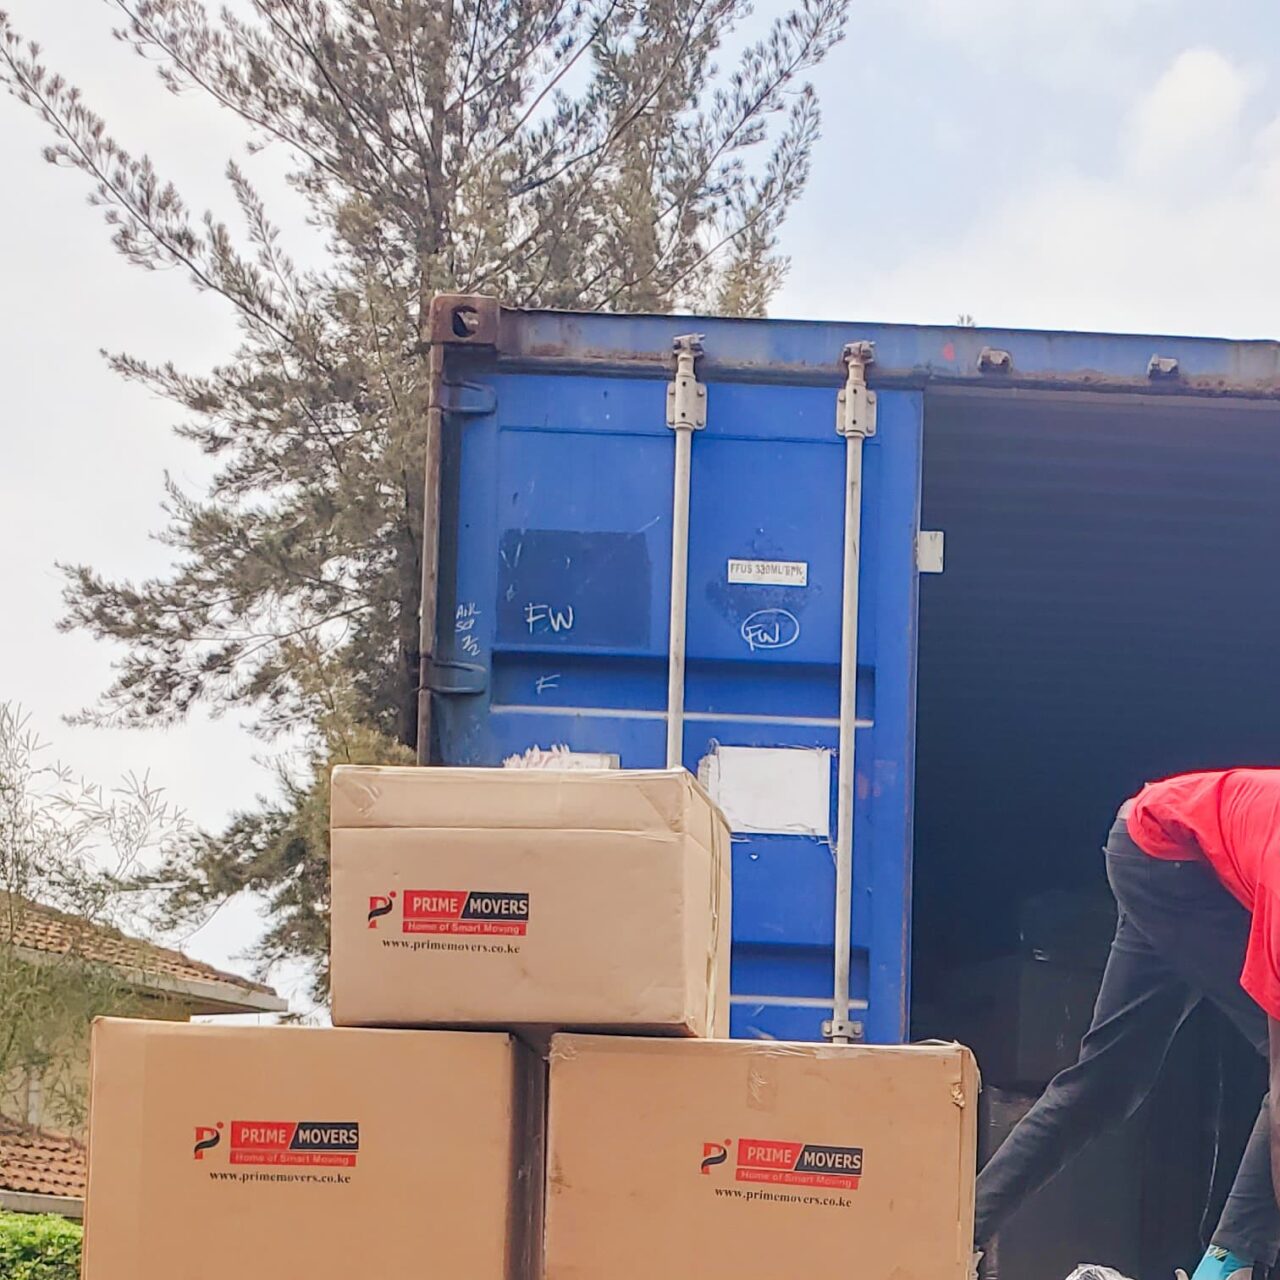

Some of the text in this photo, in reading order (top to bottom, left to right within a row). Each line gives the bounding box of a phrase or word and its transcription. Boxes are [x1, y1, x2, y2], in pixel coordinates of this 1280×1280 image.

[524, 602, 574, 634] FW
[412, 896, 459, 913] PRIME
[469, 898, 528, 915] MOVERS
[408, 921, 520, 935] Home of Smart Moving
[382, 938, 521, 954] www.primemovers.co.ke
[240, 1127, 287, 1144] PRIME
[298, 1128, 359, 1144] MOVERS
[235, 1153, 350, 1166] Home of Smart Moving
[747, 1146, 792, 1164] PRIME
[803, 1151, 862, 1170] MOVERS
[209, 1171, 351, 1184] www.primemovers.co.ke
[740, 1171, 852, 1188] Home of Smart Moving
[714, 1187, 852, 1208] www.primemovers.co.ke
